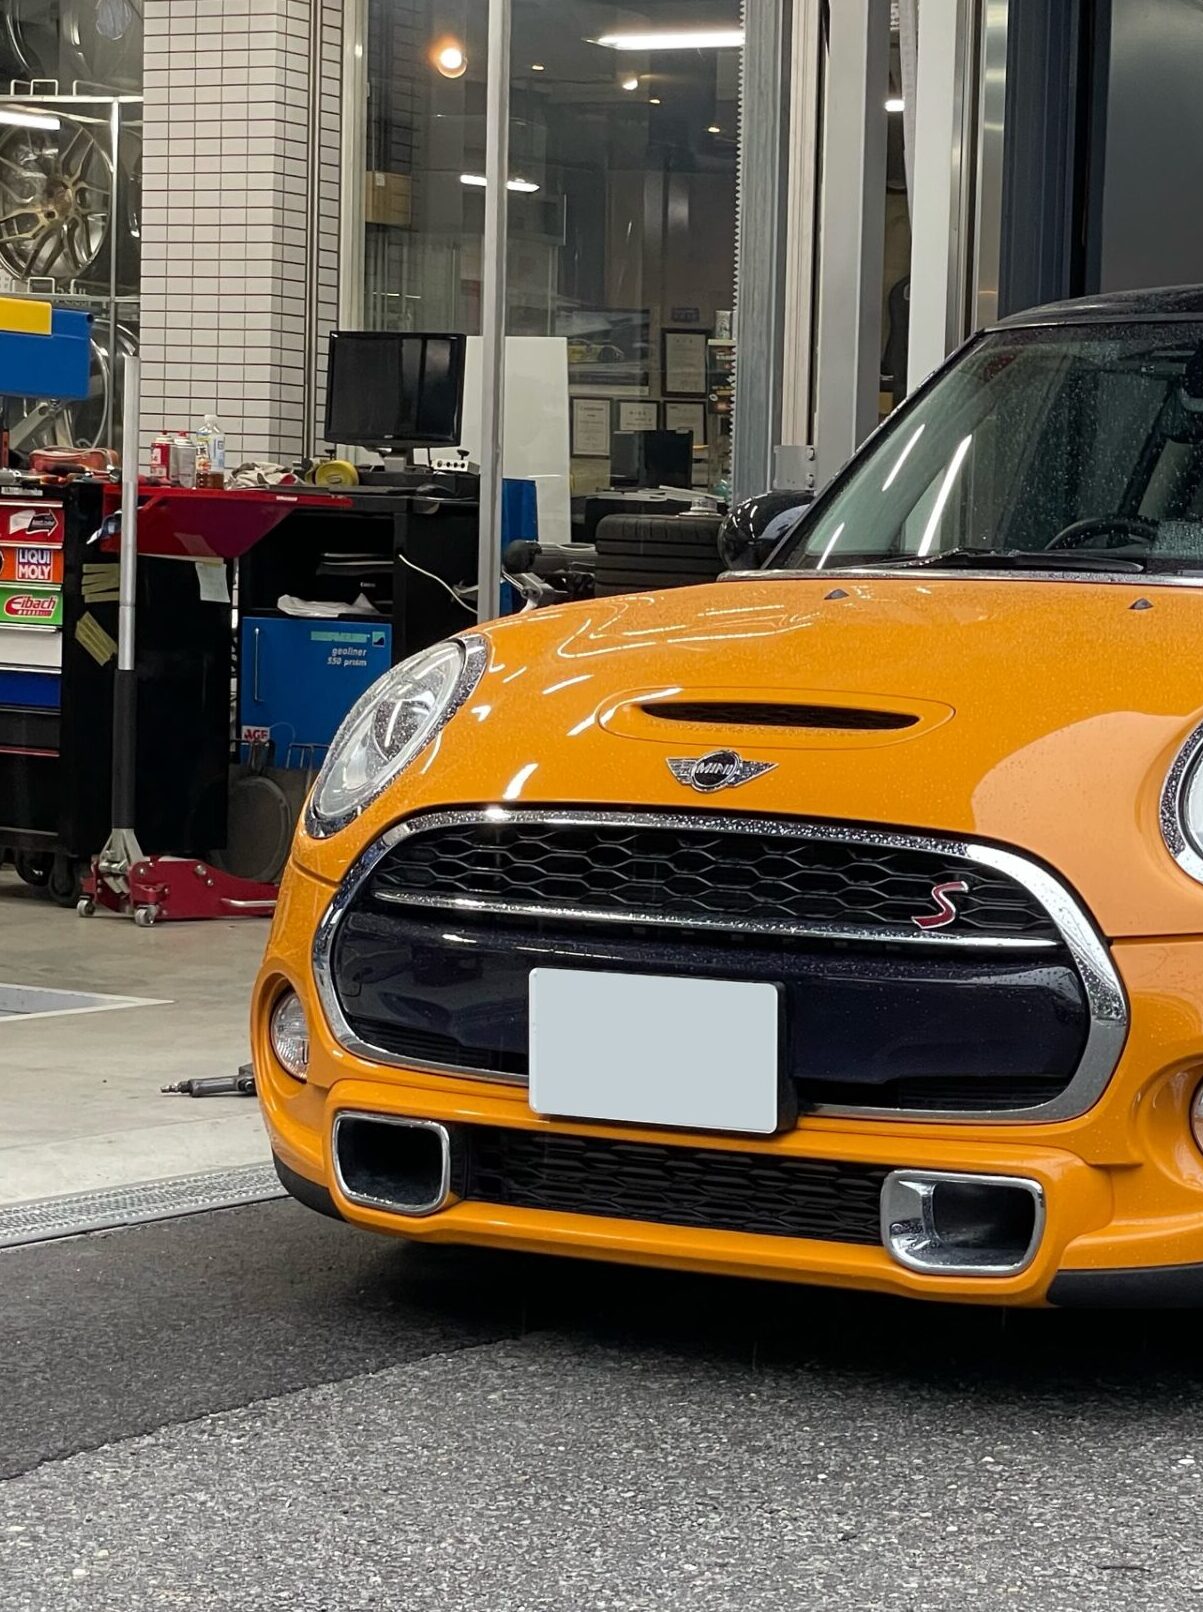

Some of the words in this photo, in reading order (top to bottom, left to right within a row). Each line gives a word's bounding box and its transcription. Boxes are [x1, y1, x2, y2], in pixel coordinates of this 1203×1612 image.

[19, 549, 51, 563] LIQUI
[19, 566, 51, 579] MOLY
[5, 595, 57, 614] Eibach
[332, 648, 367, 657] geoliner
[327, 657, 342, 666] 550
[695, 762, 734, 775] MINI
[911, 881, 969, 929] S
